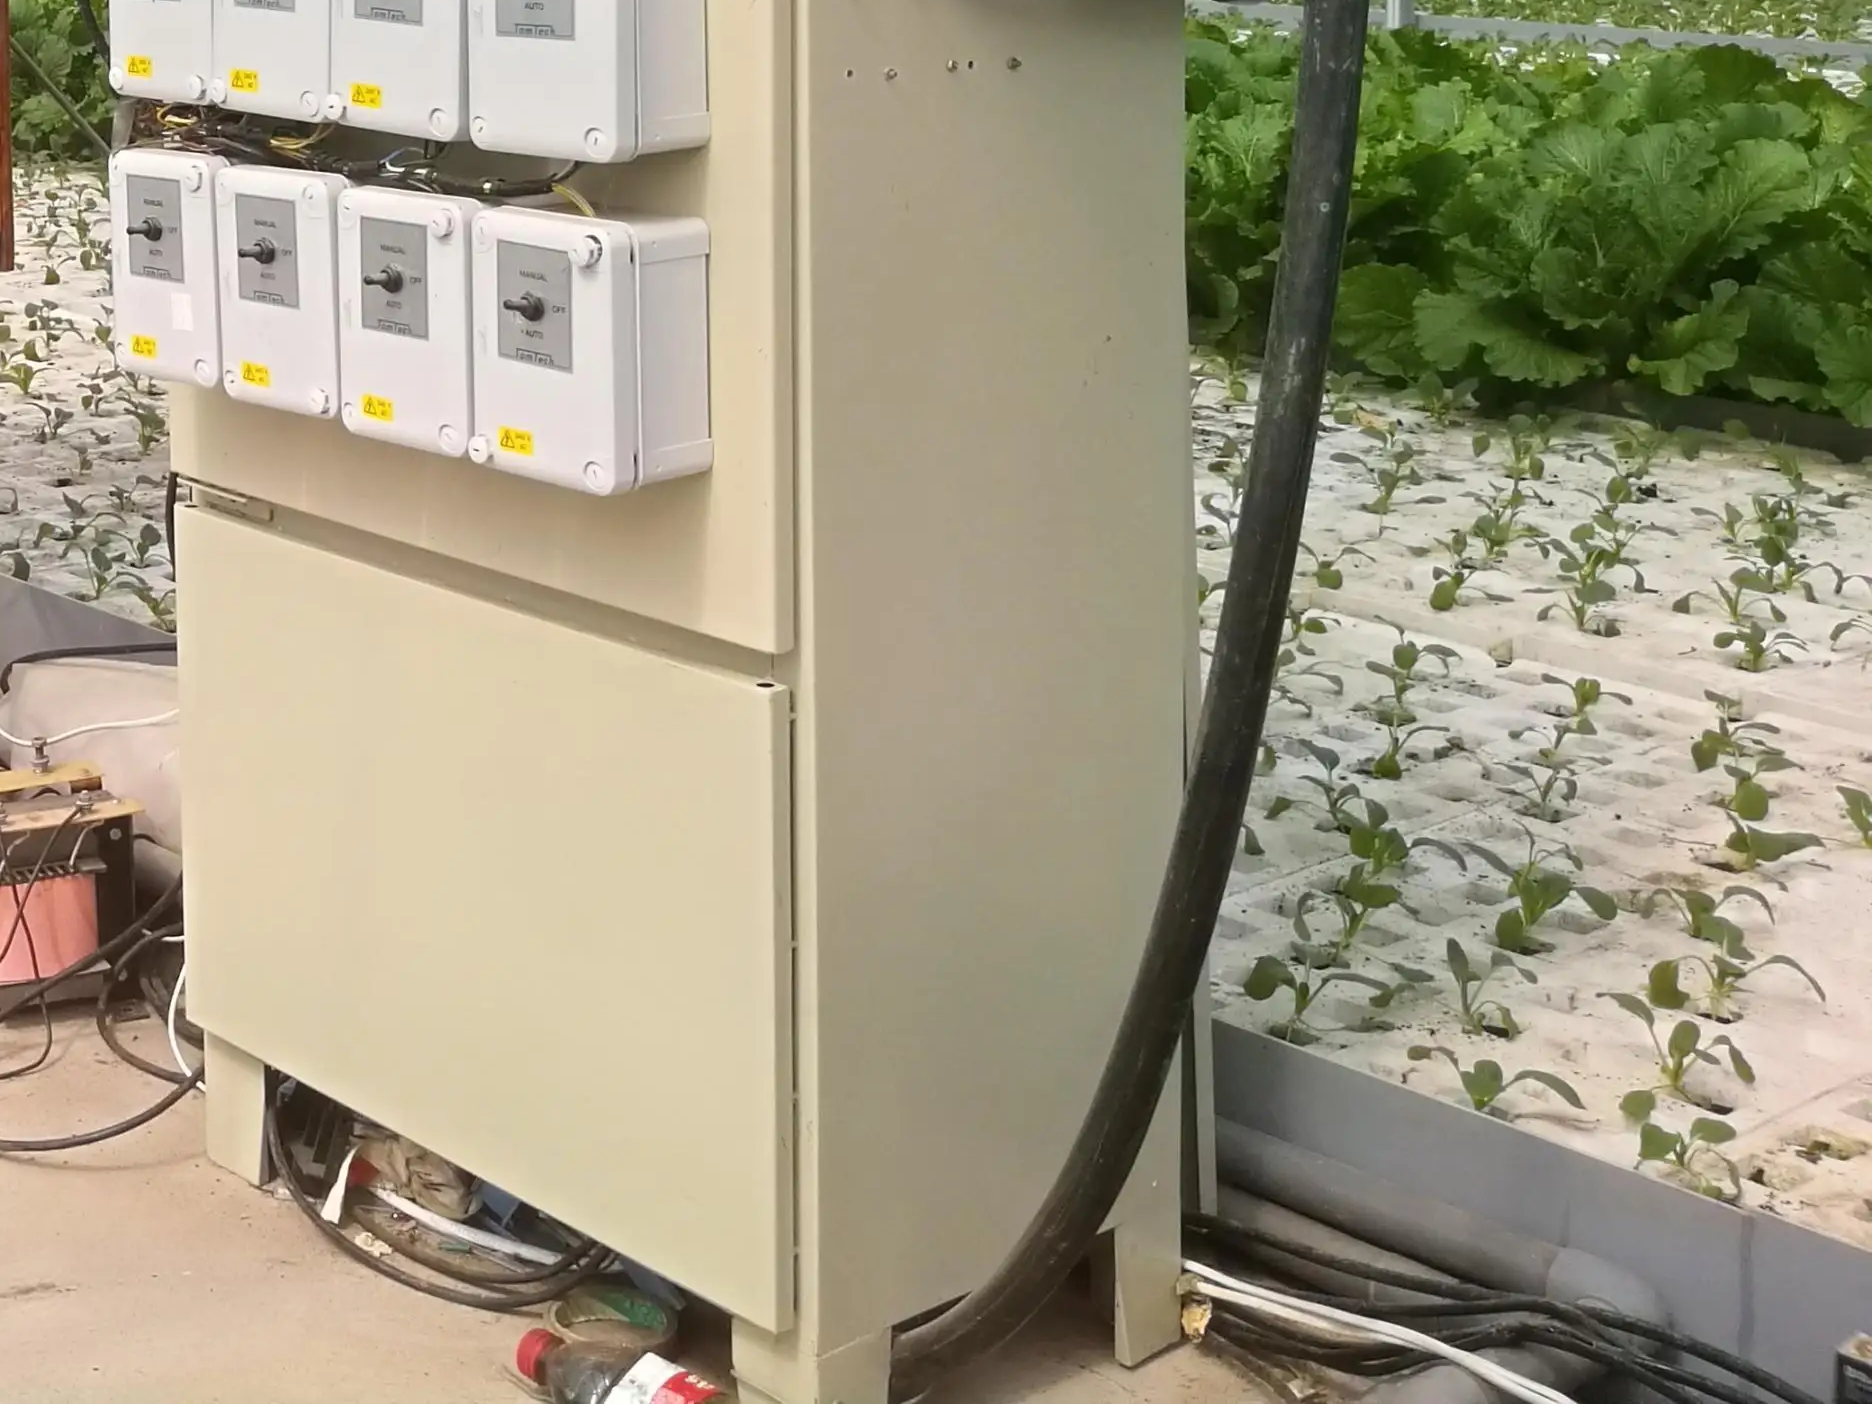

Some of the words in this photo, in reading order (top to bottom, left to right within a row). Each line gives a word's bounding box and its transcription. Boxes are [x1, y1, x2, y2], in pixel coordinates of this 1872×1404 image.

[524, 2, 544, 11] AUTO
[515, 23, 555, 36] TomTech
[380, 244, 407, 255] MANUAL
[409, 276, 423, 284] OFF
[519, 269, 549, 283] MANUAL
[386, 300, 401, 310] AUTO
[552, 305, 566, 314] OFF
[525, 329, 544, 340] AUTO
